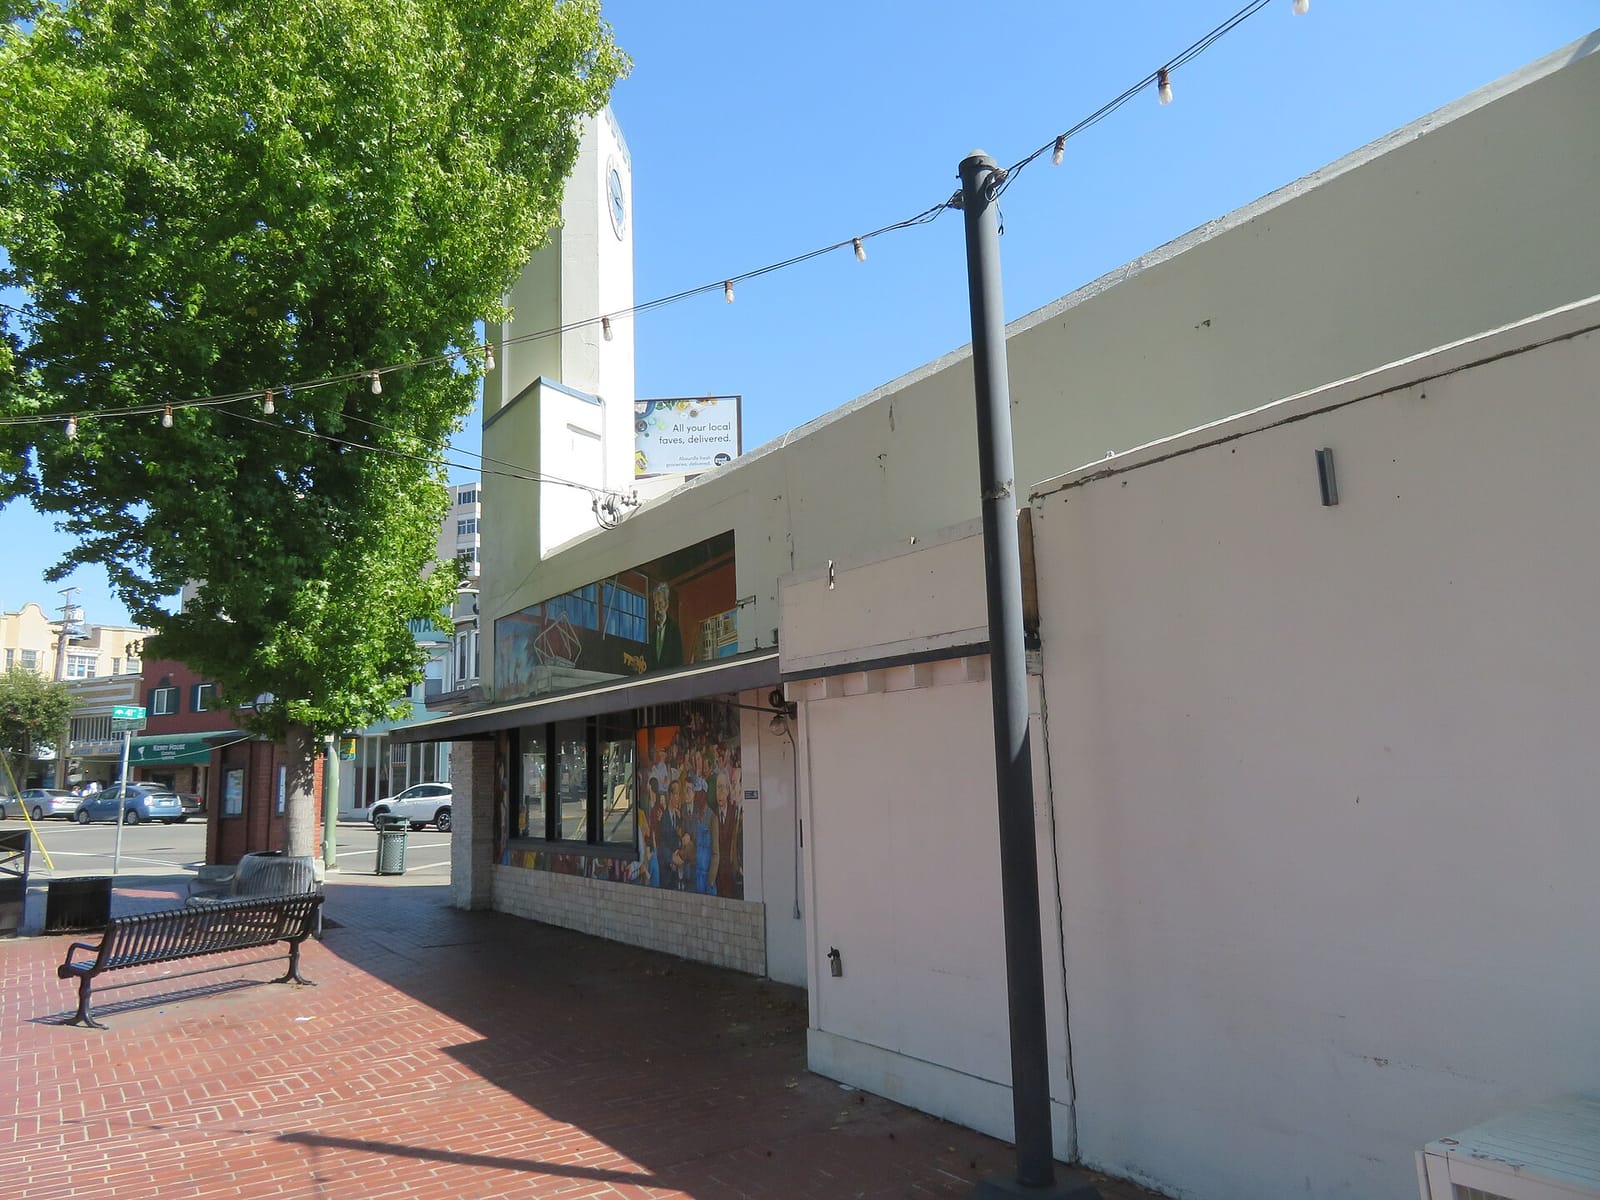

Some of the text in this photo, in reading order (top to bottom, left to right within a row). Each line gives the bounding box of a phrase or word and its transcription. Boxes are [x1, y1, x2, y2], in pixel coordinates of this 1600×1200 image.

[673, 421, 731, 434] All your local
[659, 433, 732, 445] faves, delivered.
